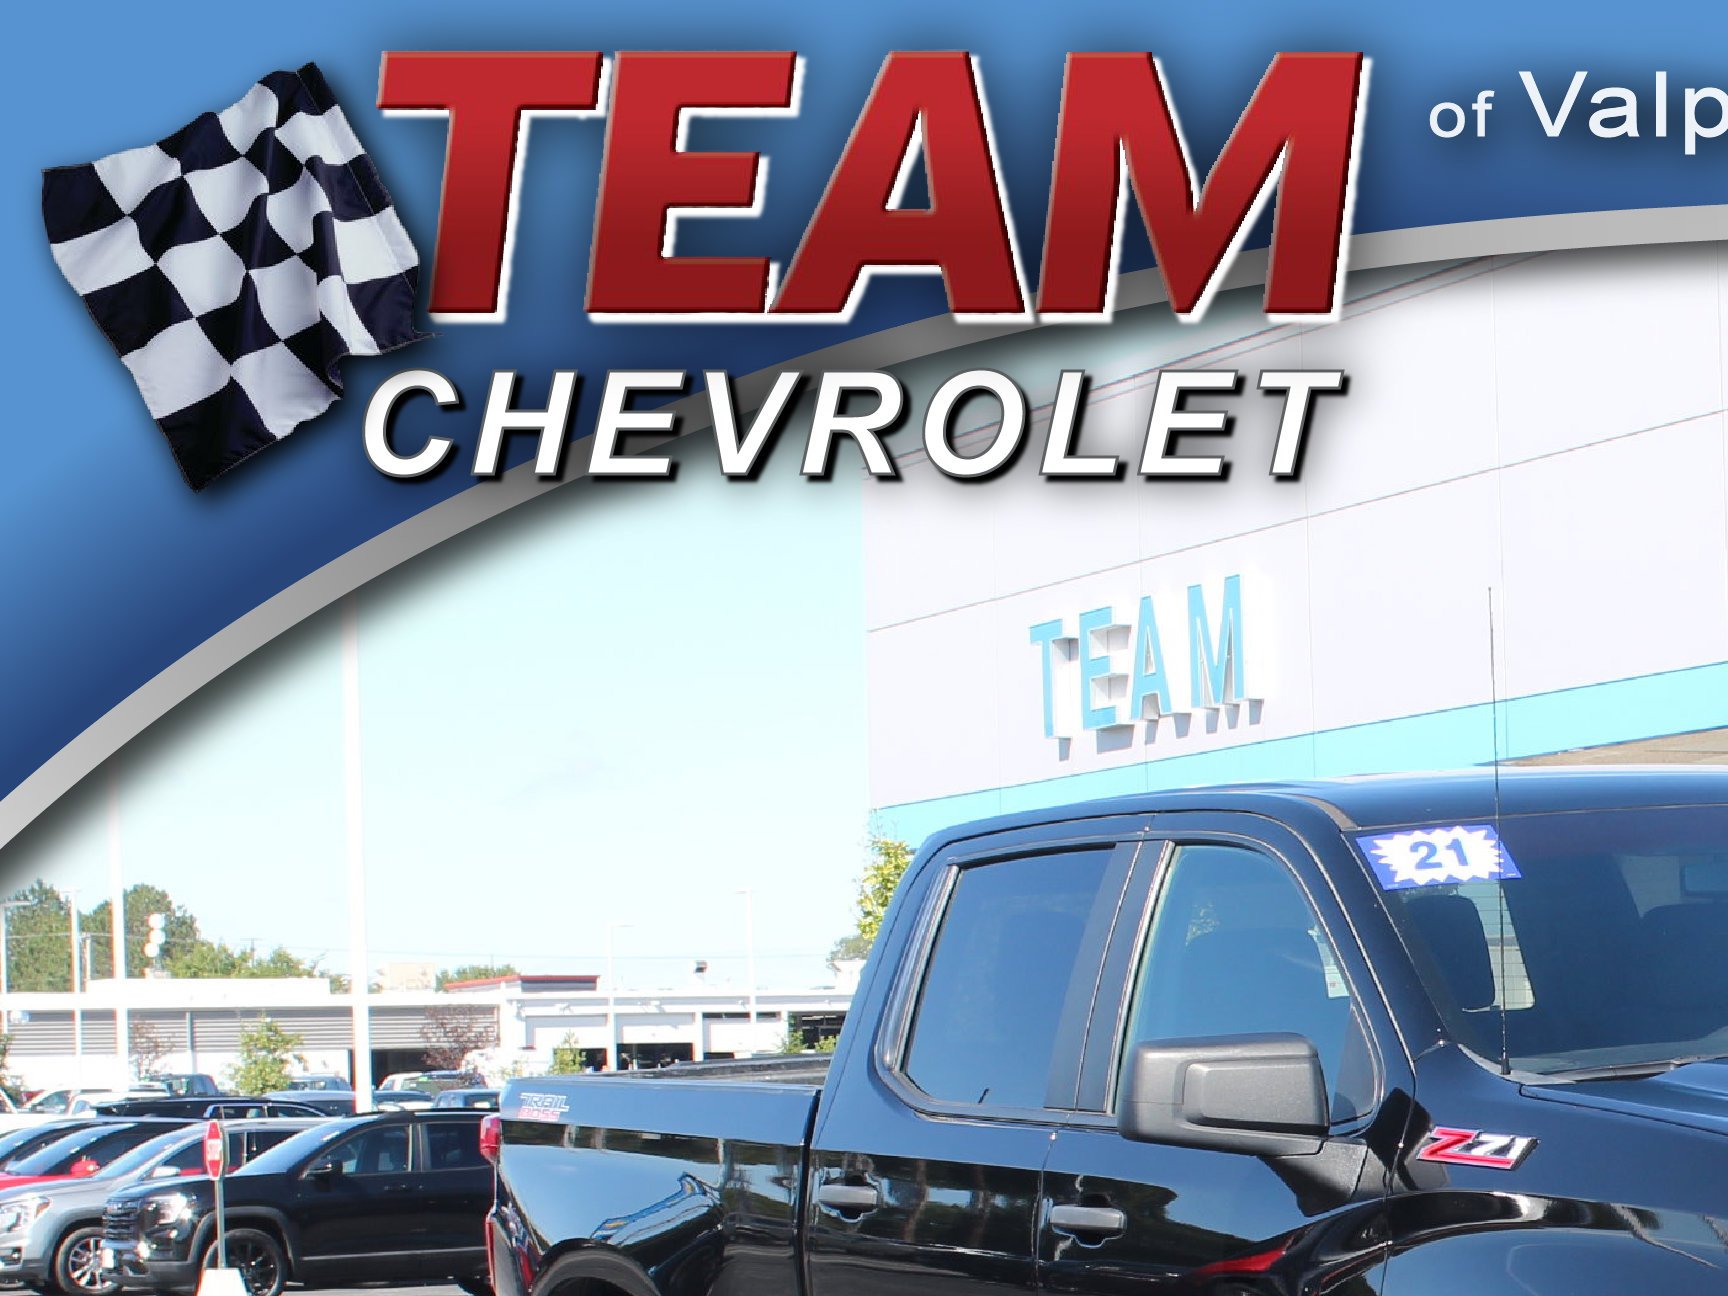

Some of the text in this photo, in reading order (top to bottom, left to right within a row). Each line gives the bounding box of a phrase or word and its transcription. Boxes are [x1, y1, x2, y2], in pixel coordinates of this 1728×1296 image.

[1029, 574, 1245, 738] TEAM
[1409, 838, 1469, 870] 21
[520, 1092, 570, 1112] TRAIL
[1416, 1126, 1539, 1170] Z71
